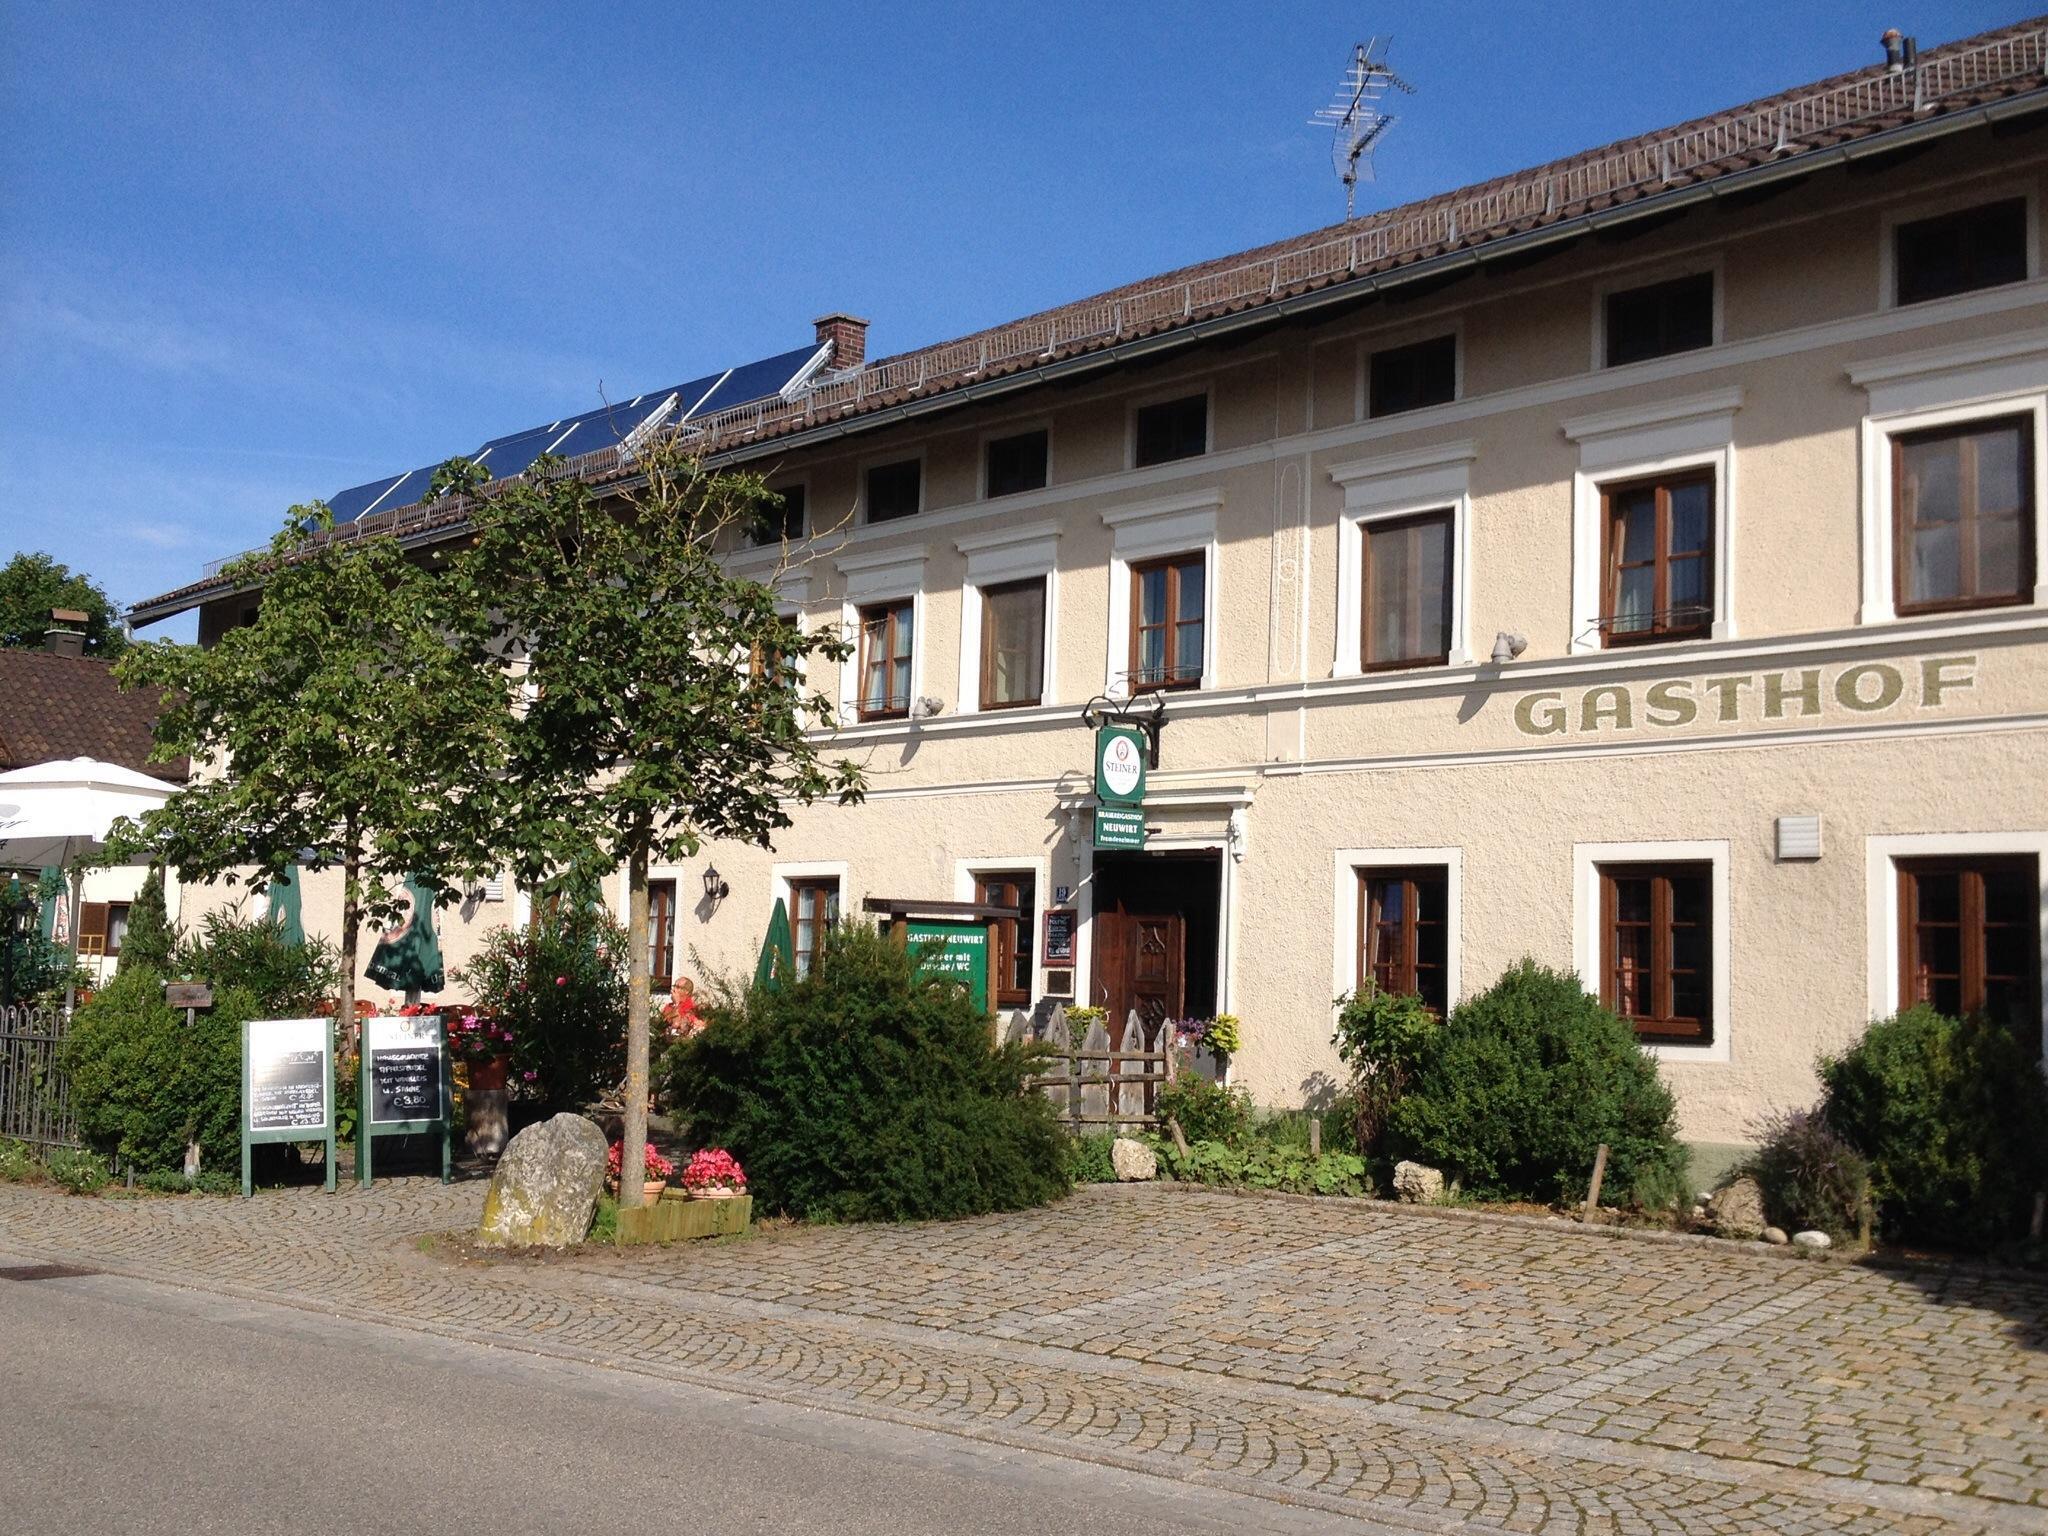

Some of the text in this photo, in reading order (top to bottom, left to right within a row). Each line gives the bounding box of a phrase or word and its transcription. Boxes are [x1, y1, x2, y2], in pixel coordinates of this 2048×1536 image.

[1513, 655, 1977, 736] GASTHOF
[1105, 761, 1138, 775] STEINER
[1102, 822, 1138, 834] NEUWIRT
[1100, 835, 1140, 844] Fremdenzimmer
[946, 934, 984, 944] NEUWIRT
[955, 952, 971, 962] mit
